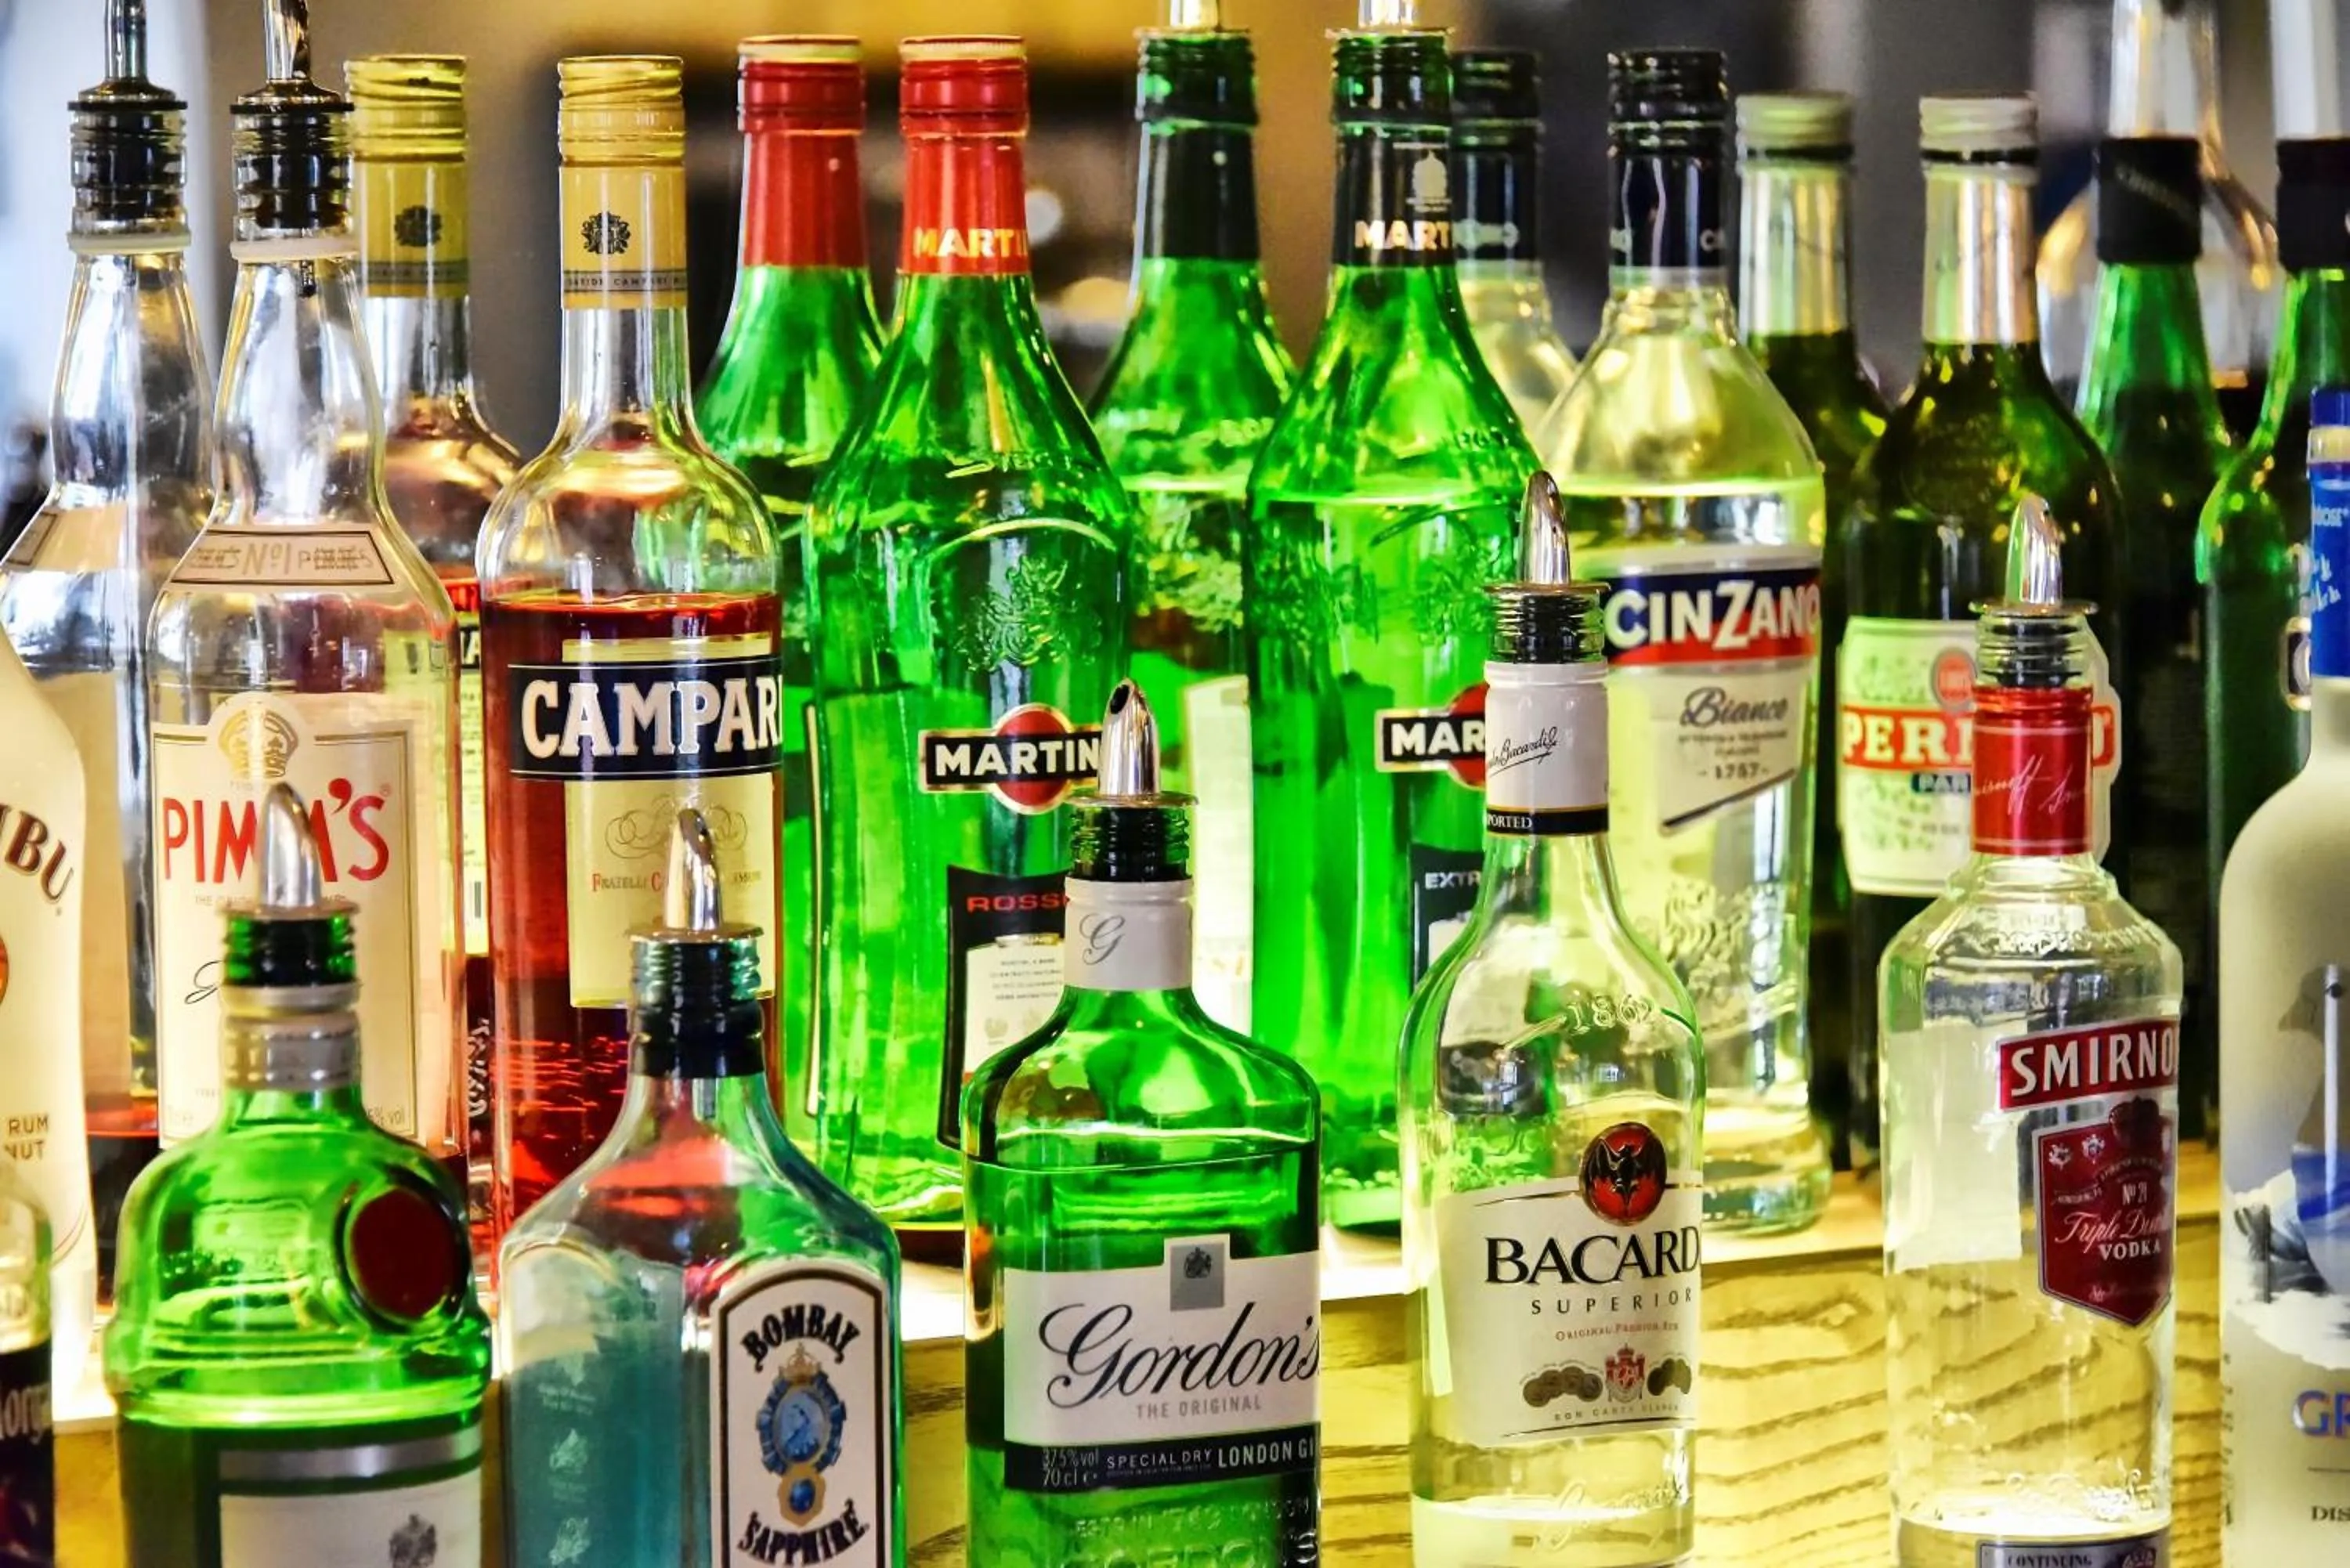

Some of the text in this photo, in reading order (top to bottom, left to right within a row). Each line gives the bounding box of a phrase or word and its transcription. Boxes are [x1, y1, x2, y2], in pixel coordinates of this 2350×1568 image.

[913, 227, 1028, 258] MARTI
[1354, 220, 1450, 251] MART
[1606, 579, 1821, 651] CINZANO
[521, 676, 783, 759] CAMPAR
[1391, 719, 1485, 757] MAR
[935, 737, 1100, 777] MARTIN
[1918, 773, 1969, 793] PAR
[1488, 815, 1533, 829] PORTED
[1424, 871, 1482, 891] EXTR
[967, 893, 1066, 913] ROSS
[1079, 912, 1125, 966] G
[2011, 1027, 2177, 1097] SMIRNO
[9, 1114, 49, 1136] RUM
[4, 1138, 44, 1161] NUT
[1485, 1225, 1700, 1284] BACARD
[2099, 1239, 2161, 1261] VODKA
[1531, 1287, 1691, 1316] SUPERIOR
[740, 1303, 861, 1374] BOMBAY
[1038, 1302, 1320, 1409] Gordon's
[1136, 1395, 1262, 1419] THE ORIGINAL
[1107, 1453, 1176, 1470] SPECIAL
[1181, 1448, 1213, 1465] DRY
[1218, 1439, 1292, 1469] LONDON
[1298, 1436, 1314, 1458] GI
[2312, 1505, 2350, 1523] DIS
[737, 1498, 870, 1566] SAPPHIRE
